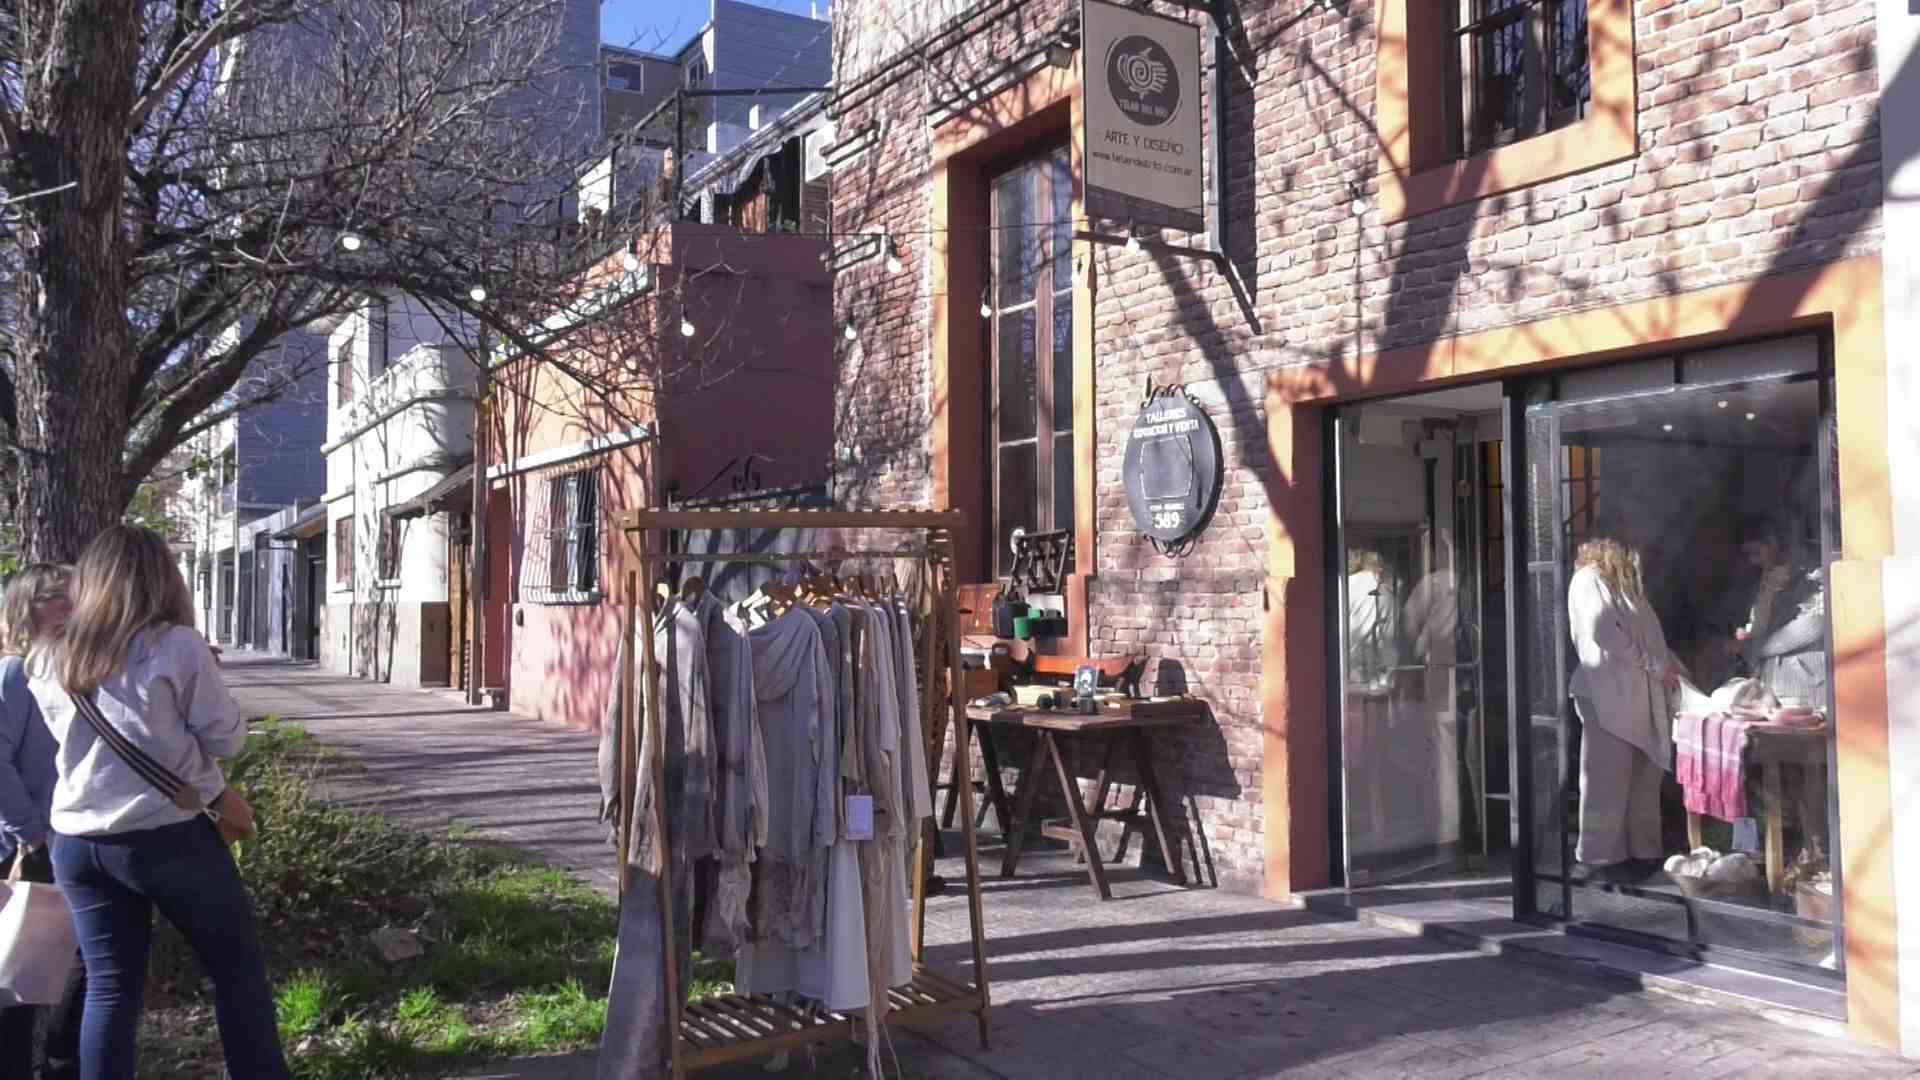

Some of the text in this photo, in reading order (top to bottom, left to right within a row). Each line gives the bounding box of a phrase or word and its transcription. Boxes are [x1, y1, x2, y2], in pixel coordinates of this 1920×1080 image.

[1104, 129, 1184, 155] ARTE Y DISEÑO
[1146, 407, 1187, 424] TALLERES
[1168, 422, 1175, 434] Y
[1175, 419, 1199, 432] VENTA
[1154, 511, 1180, 529] 589
